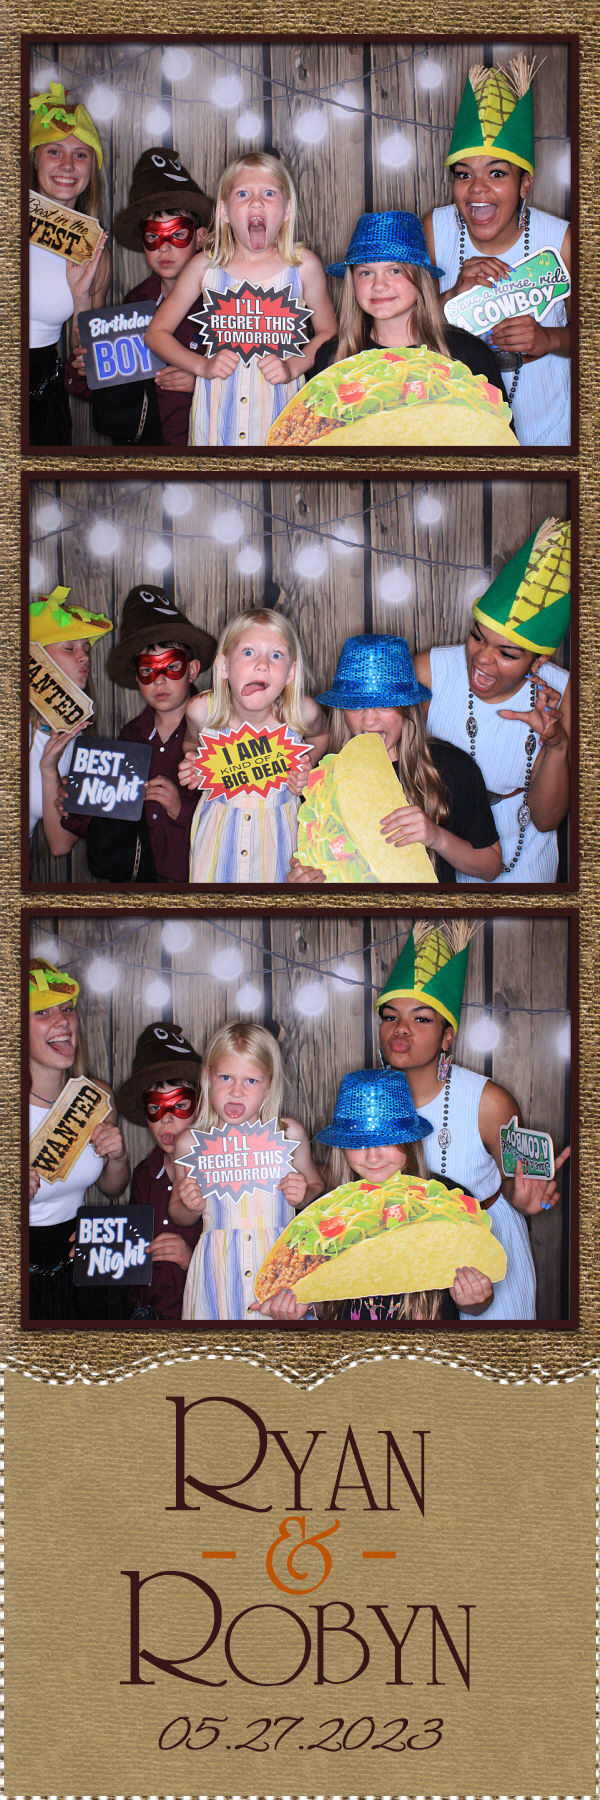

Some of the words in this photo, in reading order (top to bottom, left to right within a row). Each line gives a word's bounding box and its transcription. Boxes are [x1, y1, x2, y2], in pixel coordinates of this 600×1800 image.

[29, 198, 59, 219] Best
[54, 215, 68, 226] in
[69, 220, 89, 234] the
[236, 298, 264, 315] I'LL
[446, 295, 481, 318] Save
[482, 289, 493, 300] a
[539, 267, 569, 284] ride
[472, 284, 555, 328] COWBOY
[211, 314, 261, 330] REGRET
[264, 316, 296, 331] THIS
[217, 330, 293, 345] TOMORROW
[93, 334, 151, 380] BOY
[29, 655, 84, 725] ANTED
[73, 747, 126, 777] BEST
[220, 762, 251, 775] KIND
[254, 754, 272, 765] OF
[276, 751, 285, 759] A
[222, 746, 233, 765] I
[236, 735, 273, 761] AM
[222, 770, 250, 790] BIG
[251, 758, 292, 780] DEAL
[77, 774, 145, 812] Night
[31, 1085, 102, 1173] WANTED
[222, 1135, 251, 1152] I'LL
[198, 1152, 249, 1170] REGRET
[252, 1149, 283, 1166] THIS
[506, 1129, 540, 1161] COWBOY
[540, 1138, 549, 1161] A
[205, 1166, 281, 1184] TOMORROW
[79, 1217, 128, 1244] BEST
[87, 1238, 151, 1280] Night
